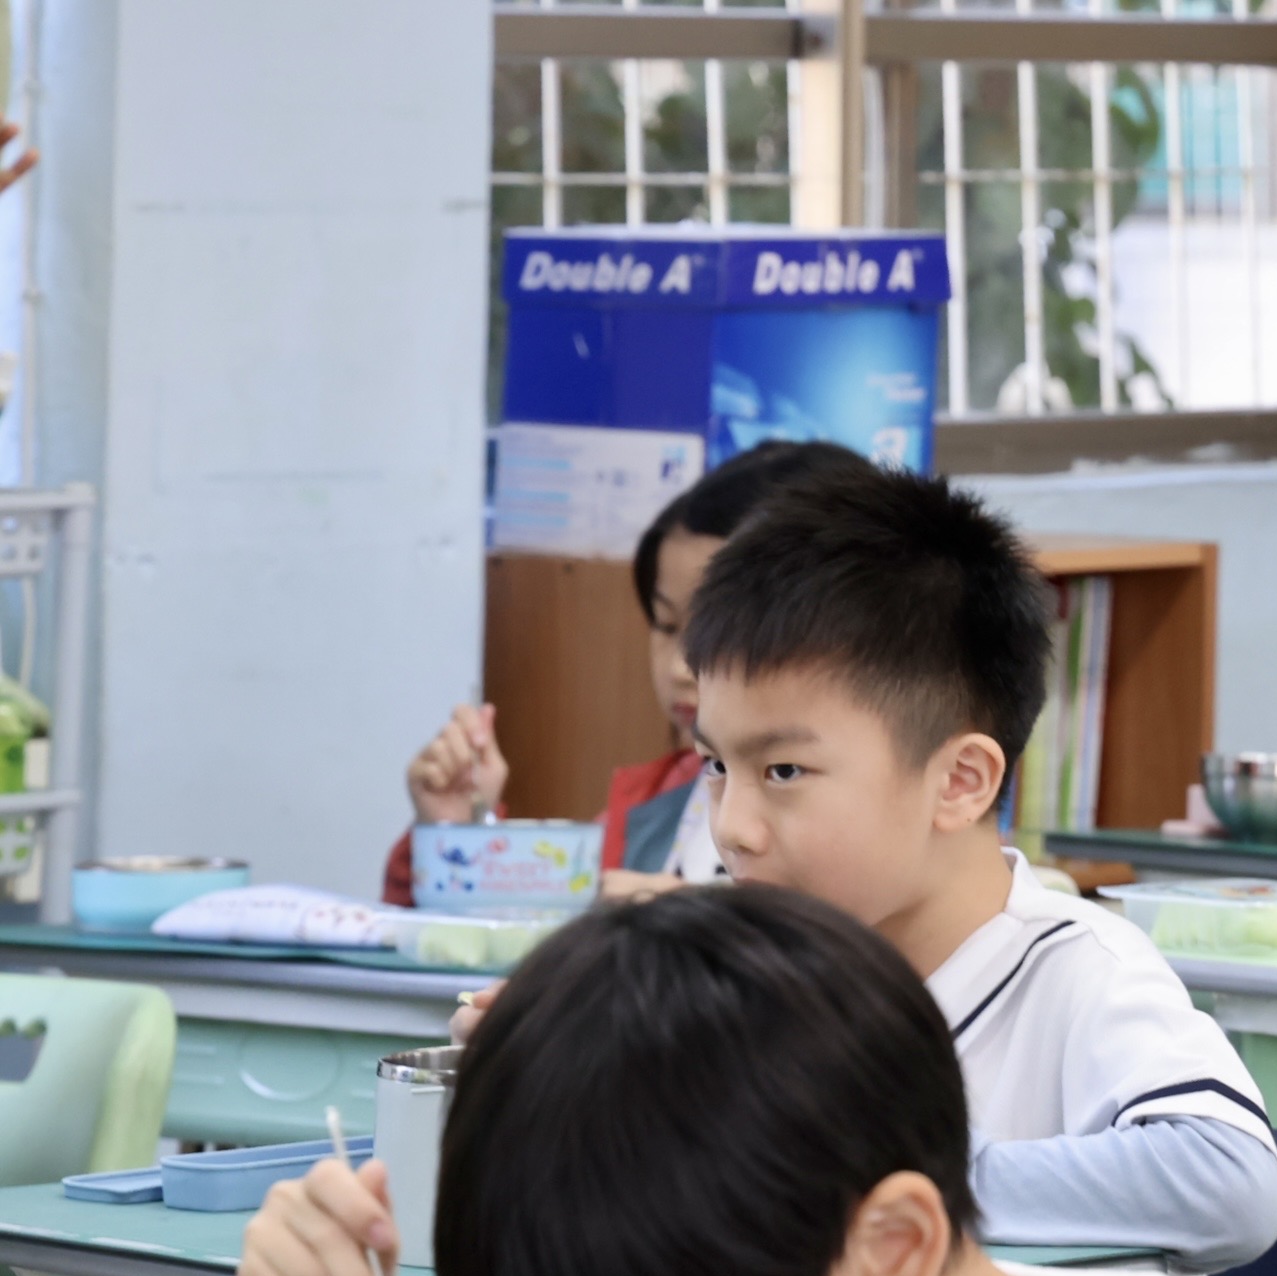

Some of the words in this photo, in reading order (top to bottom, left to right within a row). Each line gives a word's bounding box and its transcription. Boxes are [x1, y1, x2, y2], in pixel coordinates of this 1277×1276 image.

[519, 250, 653, 294] Double
[658, 253, 692, 294] A
[752, 250, 881, 296] Double
[885, 248, 915, 292] A
